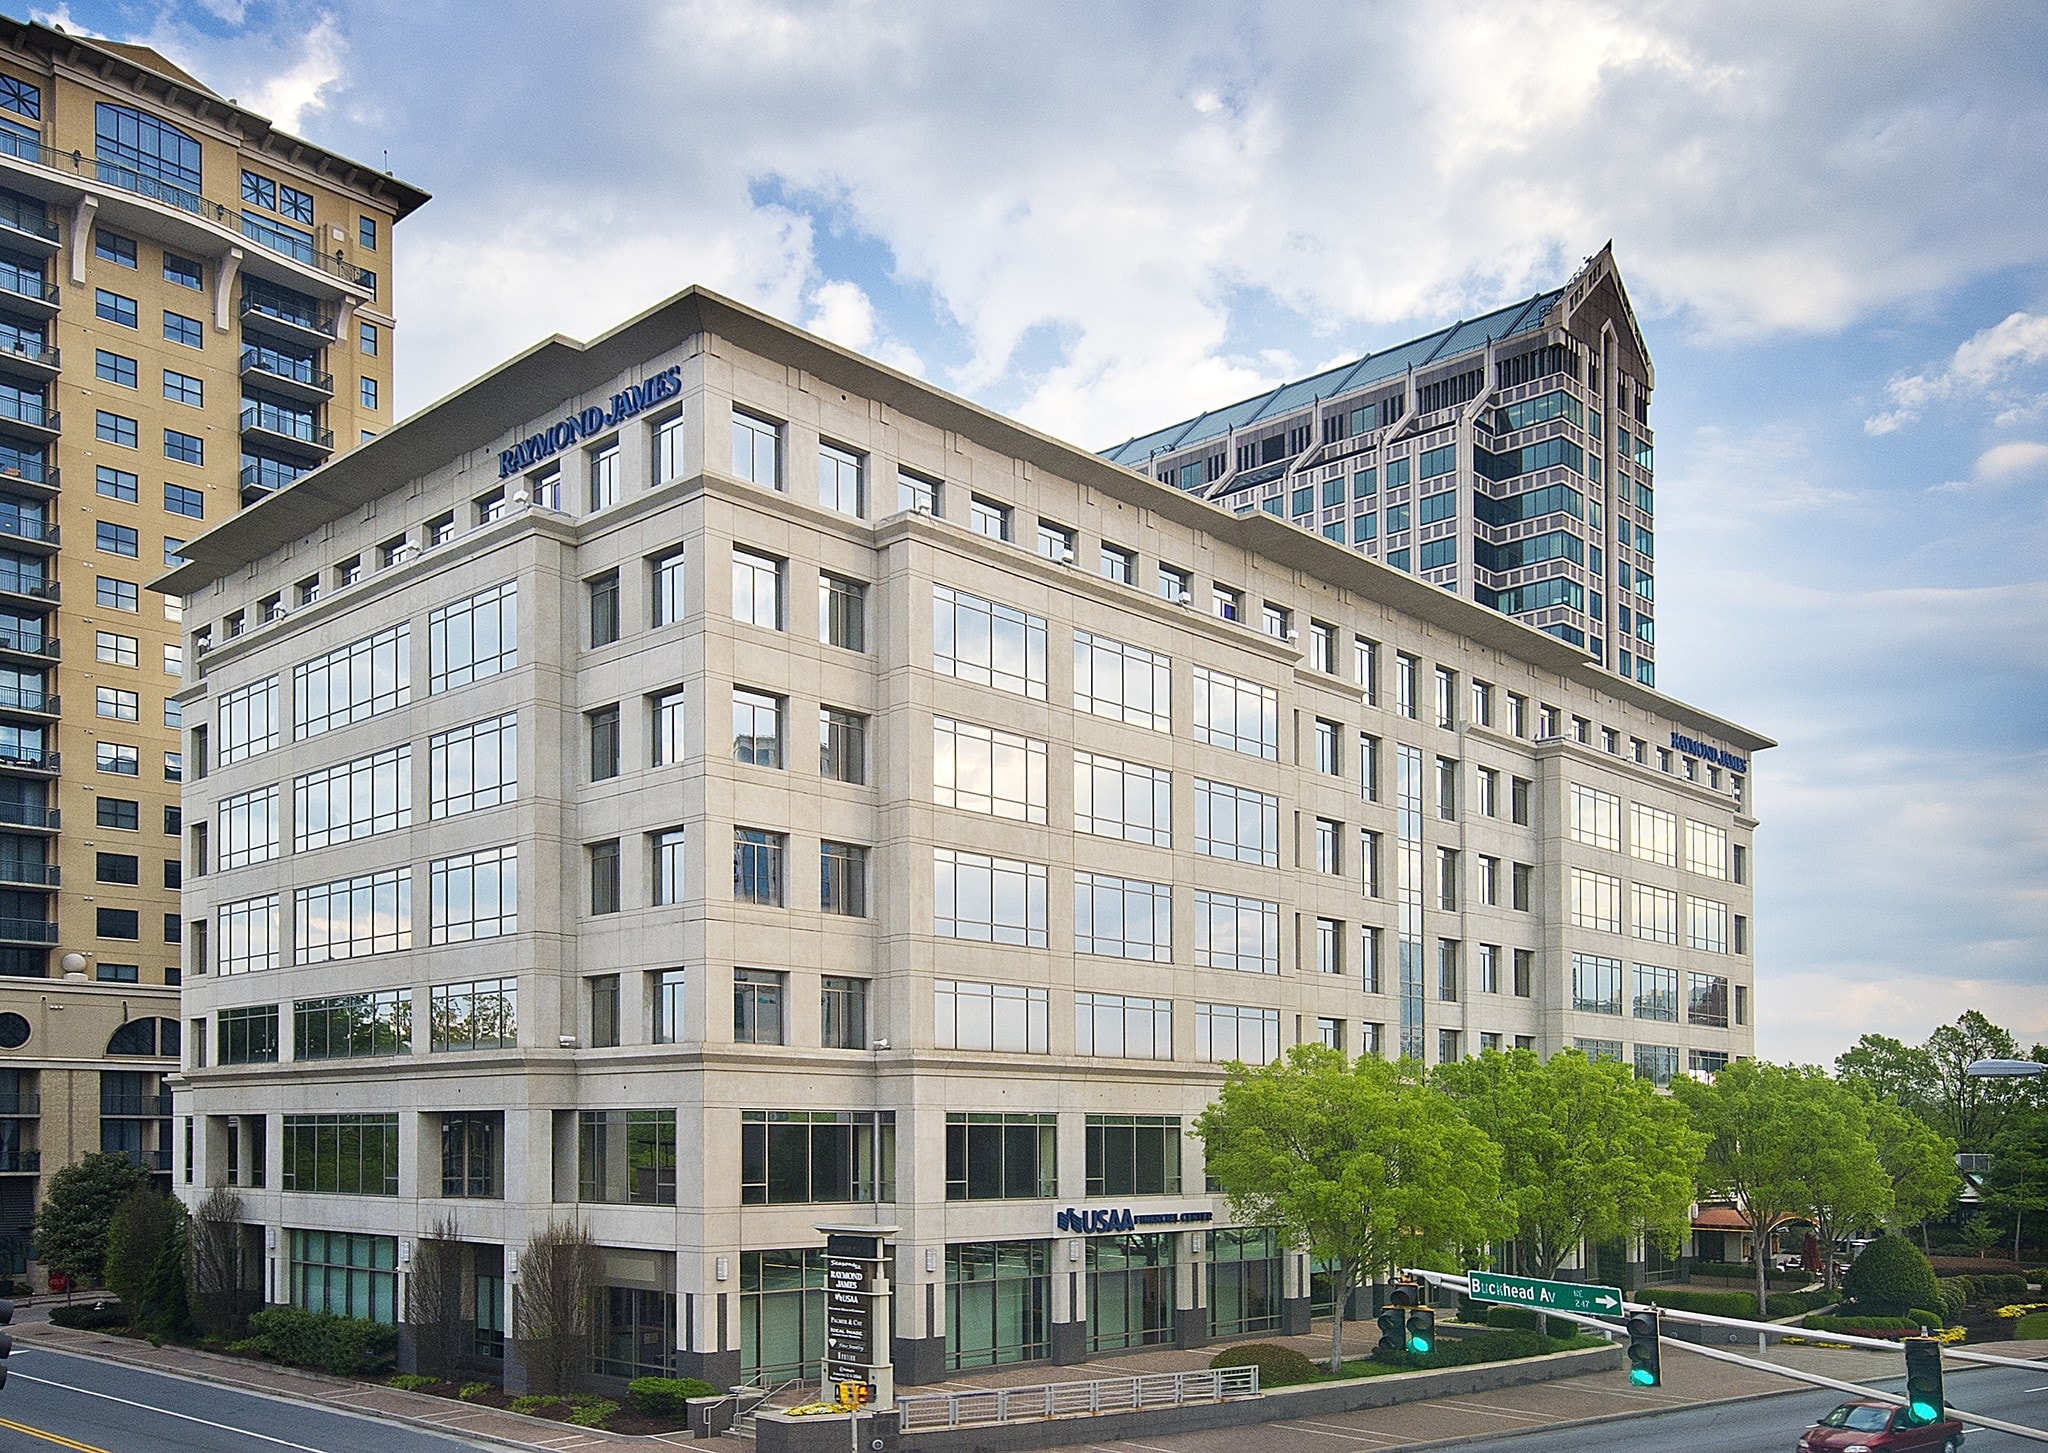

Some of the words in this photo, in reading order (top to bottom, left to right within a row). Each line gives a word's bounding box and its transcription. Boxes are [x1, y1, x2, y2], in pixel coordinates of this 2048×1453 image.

[498, 405, 604, 478] RAYMOND
[603, 365, 682, 427] JAMES
[1671, 732, 1718, 762] RAYMOND
[1718, 751, 1747, 773] JAMES
[1082, 1208, 1135, 1234] USAA
[1134, 1213, 1180, 1224] FINANCIAL
[1180, 1212, 1213, 1222] CENTER
[830, 1270, 863, 1281] RAYMOND
[835, 1280, 858, 1289] JAMES
[1472, 1279, 1534, 1300] Buckhead
[1540, 1287, 1555, 1302] Av
[1573, 1289, 1584, 1298] NE
[843, 1294, 859, 1304] USAA
[1574, 1299, 1590, 1308] 247
